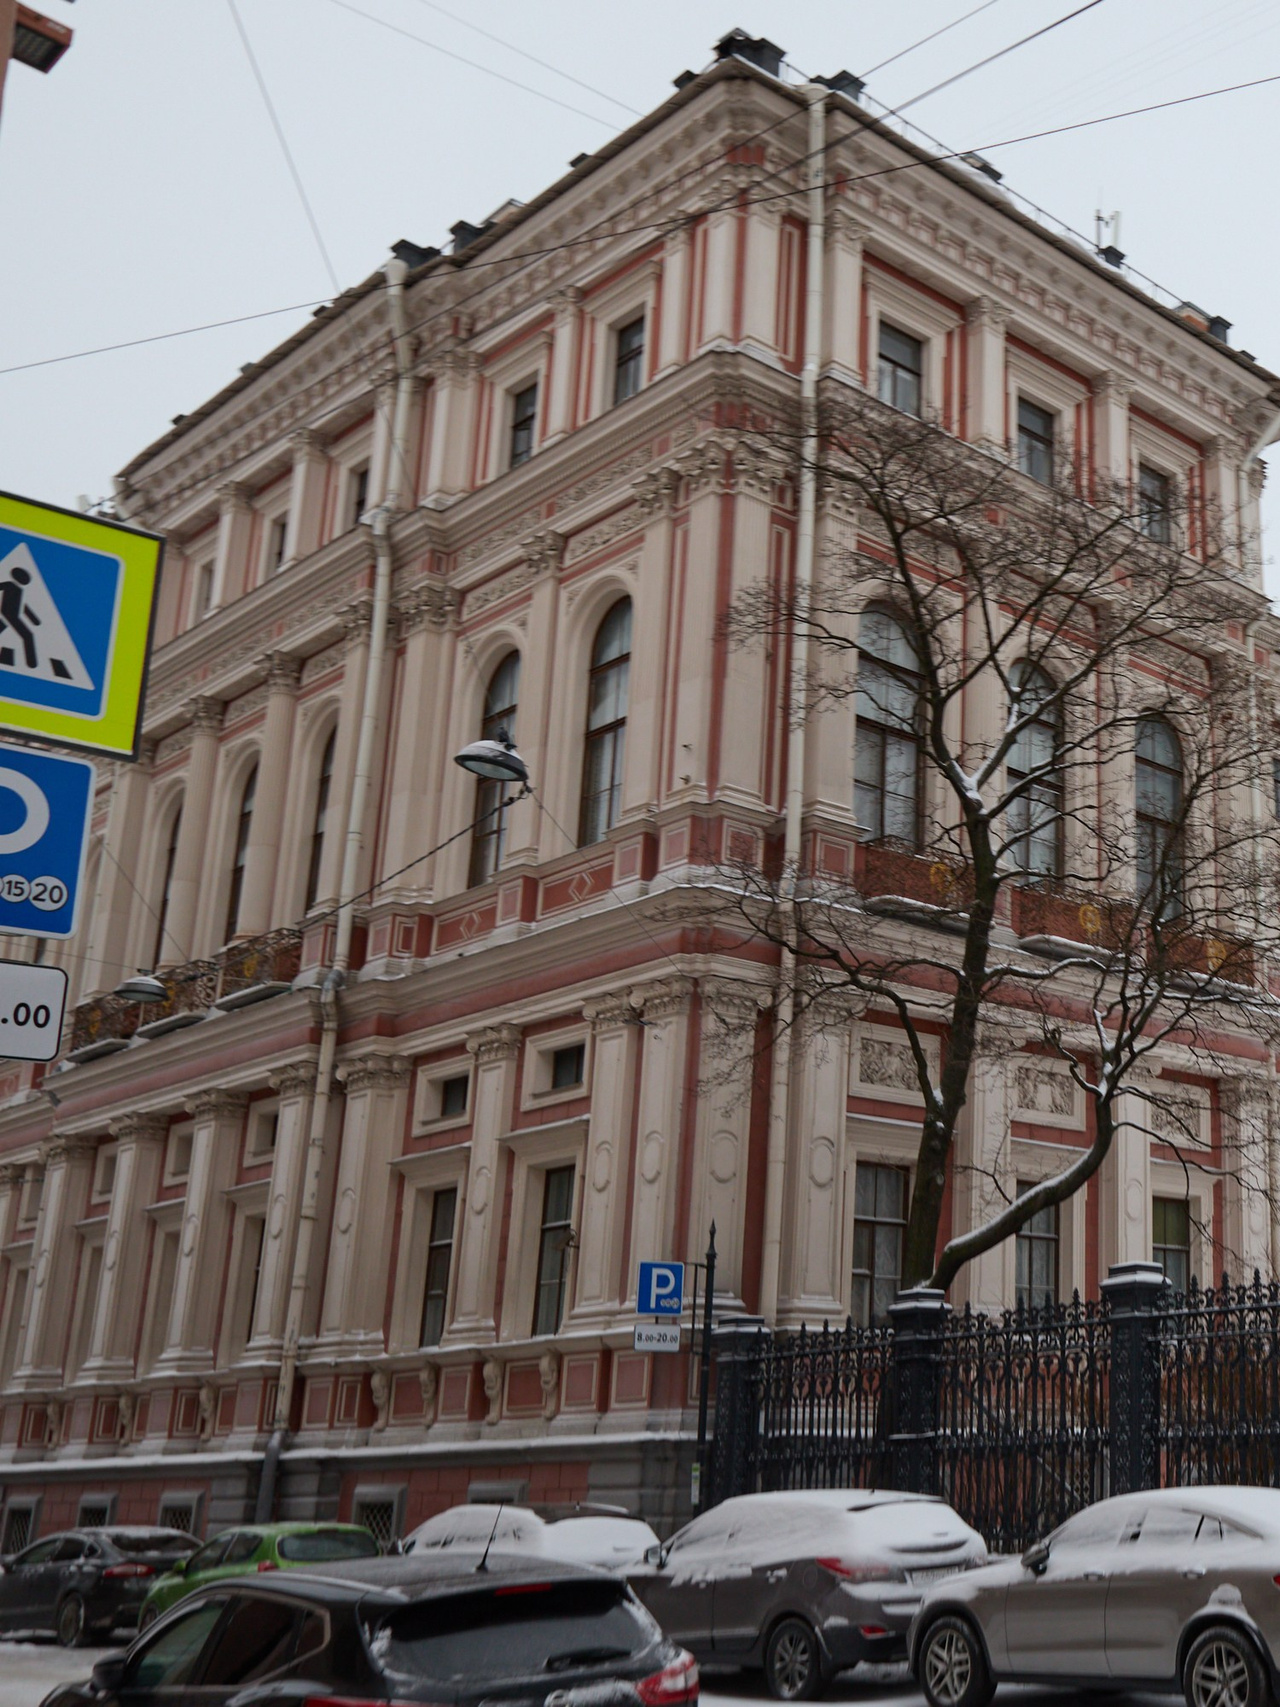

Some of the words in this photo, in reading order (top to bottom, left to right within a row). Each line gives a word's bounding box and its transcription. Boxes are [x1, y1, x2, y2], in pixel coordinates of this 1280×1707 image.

[5, 880, 25, 897] 15
[32, 882, 63, 904] 20
[650, 1267, 676, 1309] P
